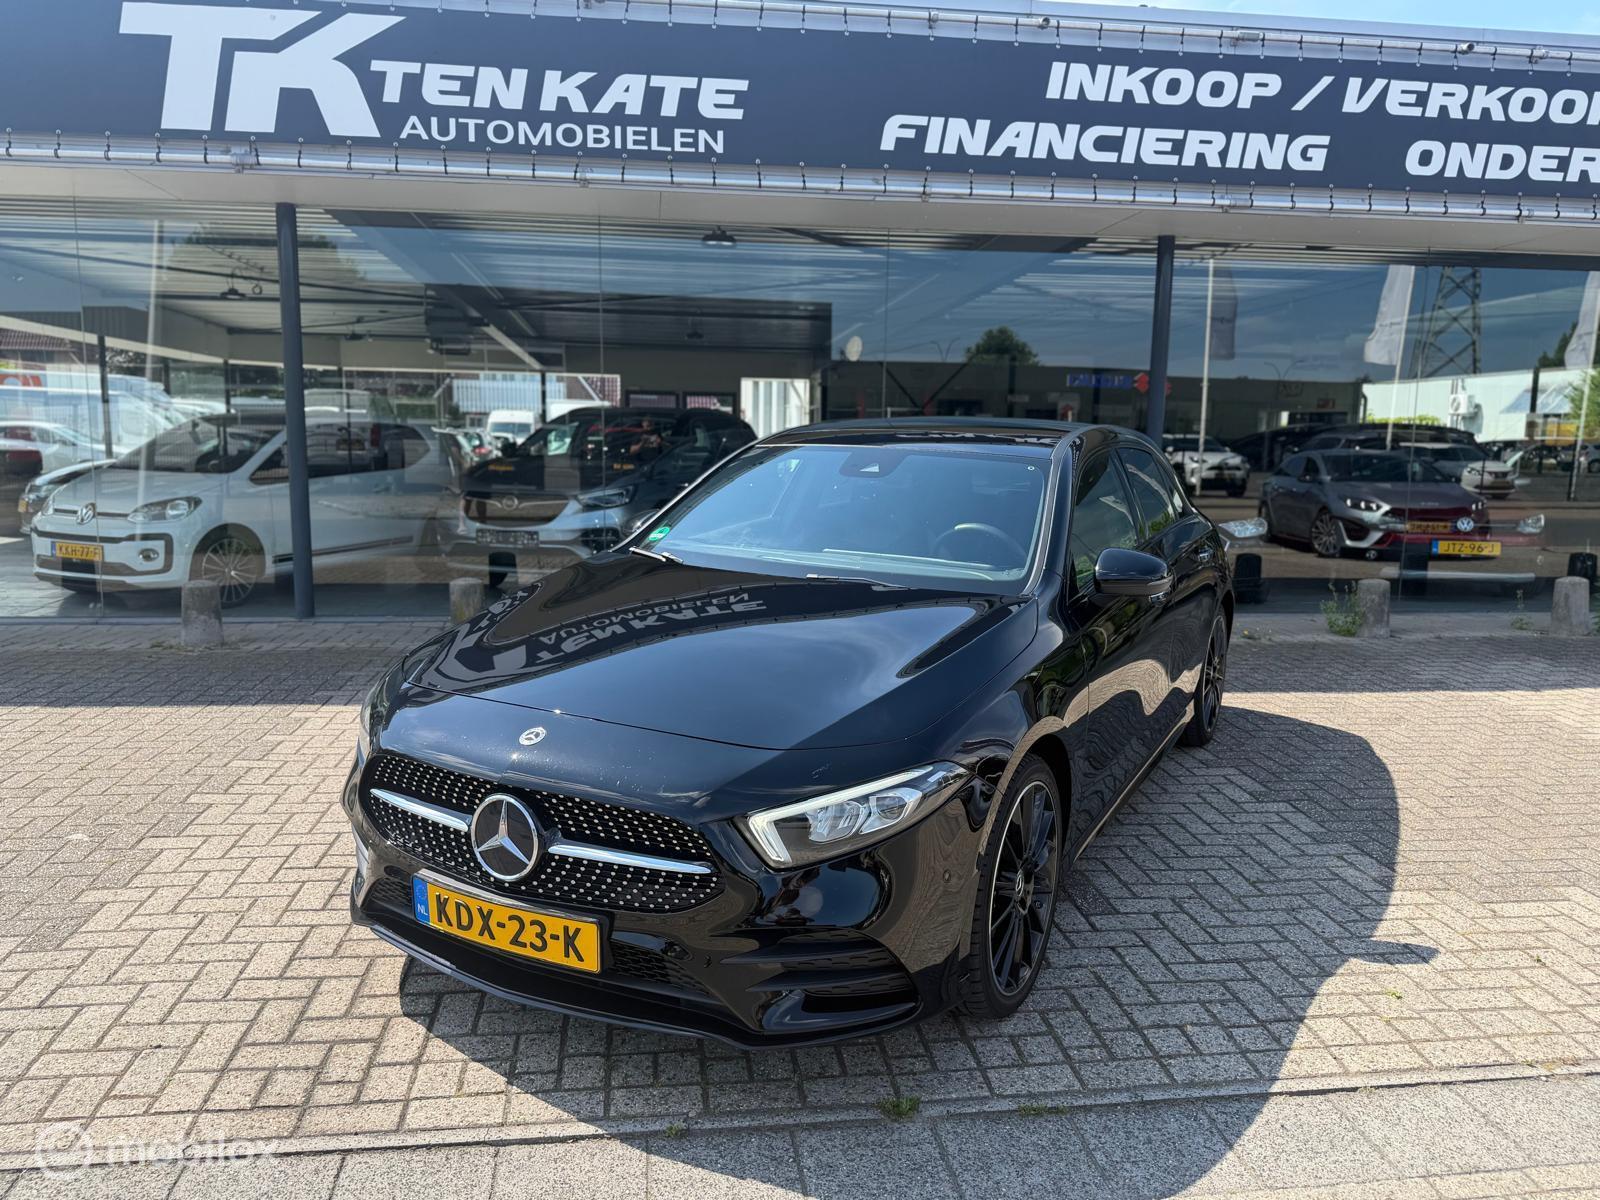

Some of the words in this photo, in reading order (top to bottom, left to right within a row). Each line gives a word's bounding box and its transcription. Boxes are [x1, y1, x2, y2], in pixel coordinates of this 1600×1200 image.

[369, 59, 528, 110] TEN
[539, 70, 750, 121] KATE
[1045, 61, 1282, 110] INKOOP
[1291, 75, 1336, 112] /
[399, 114, 725, 154] AUTOMOBIELEN
[879, 114, 1332, 172] FINANCIERING
[1444, 542, 1495, 554] JTZ-96-J
[417, 904, 428, 916] NL
[435, 892, 584, 963] KDX-23-K
